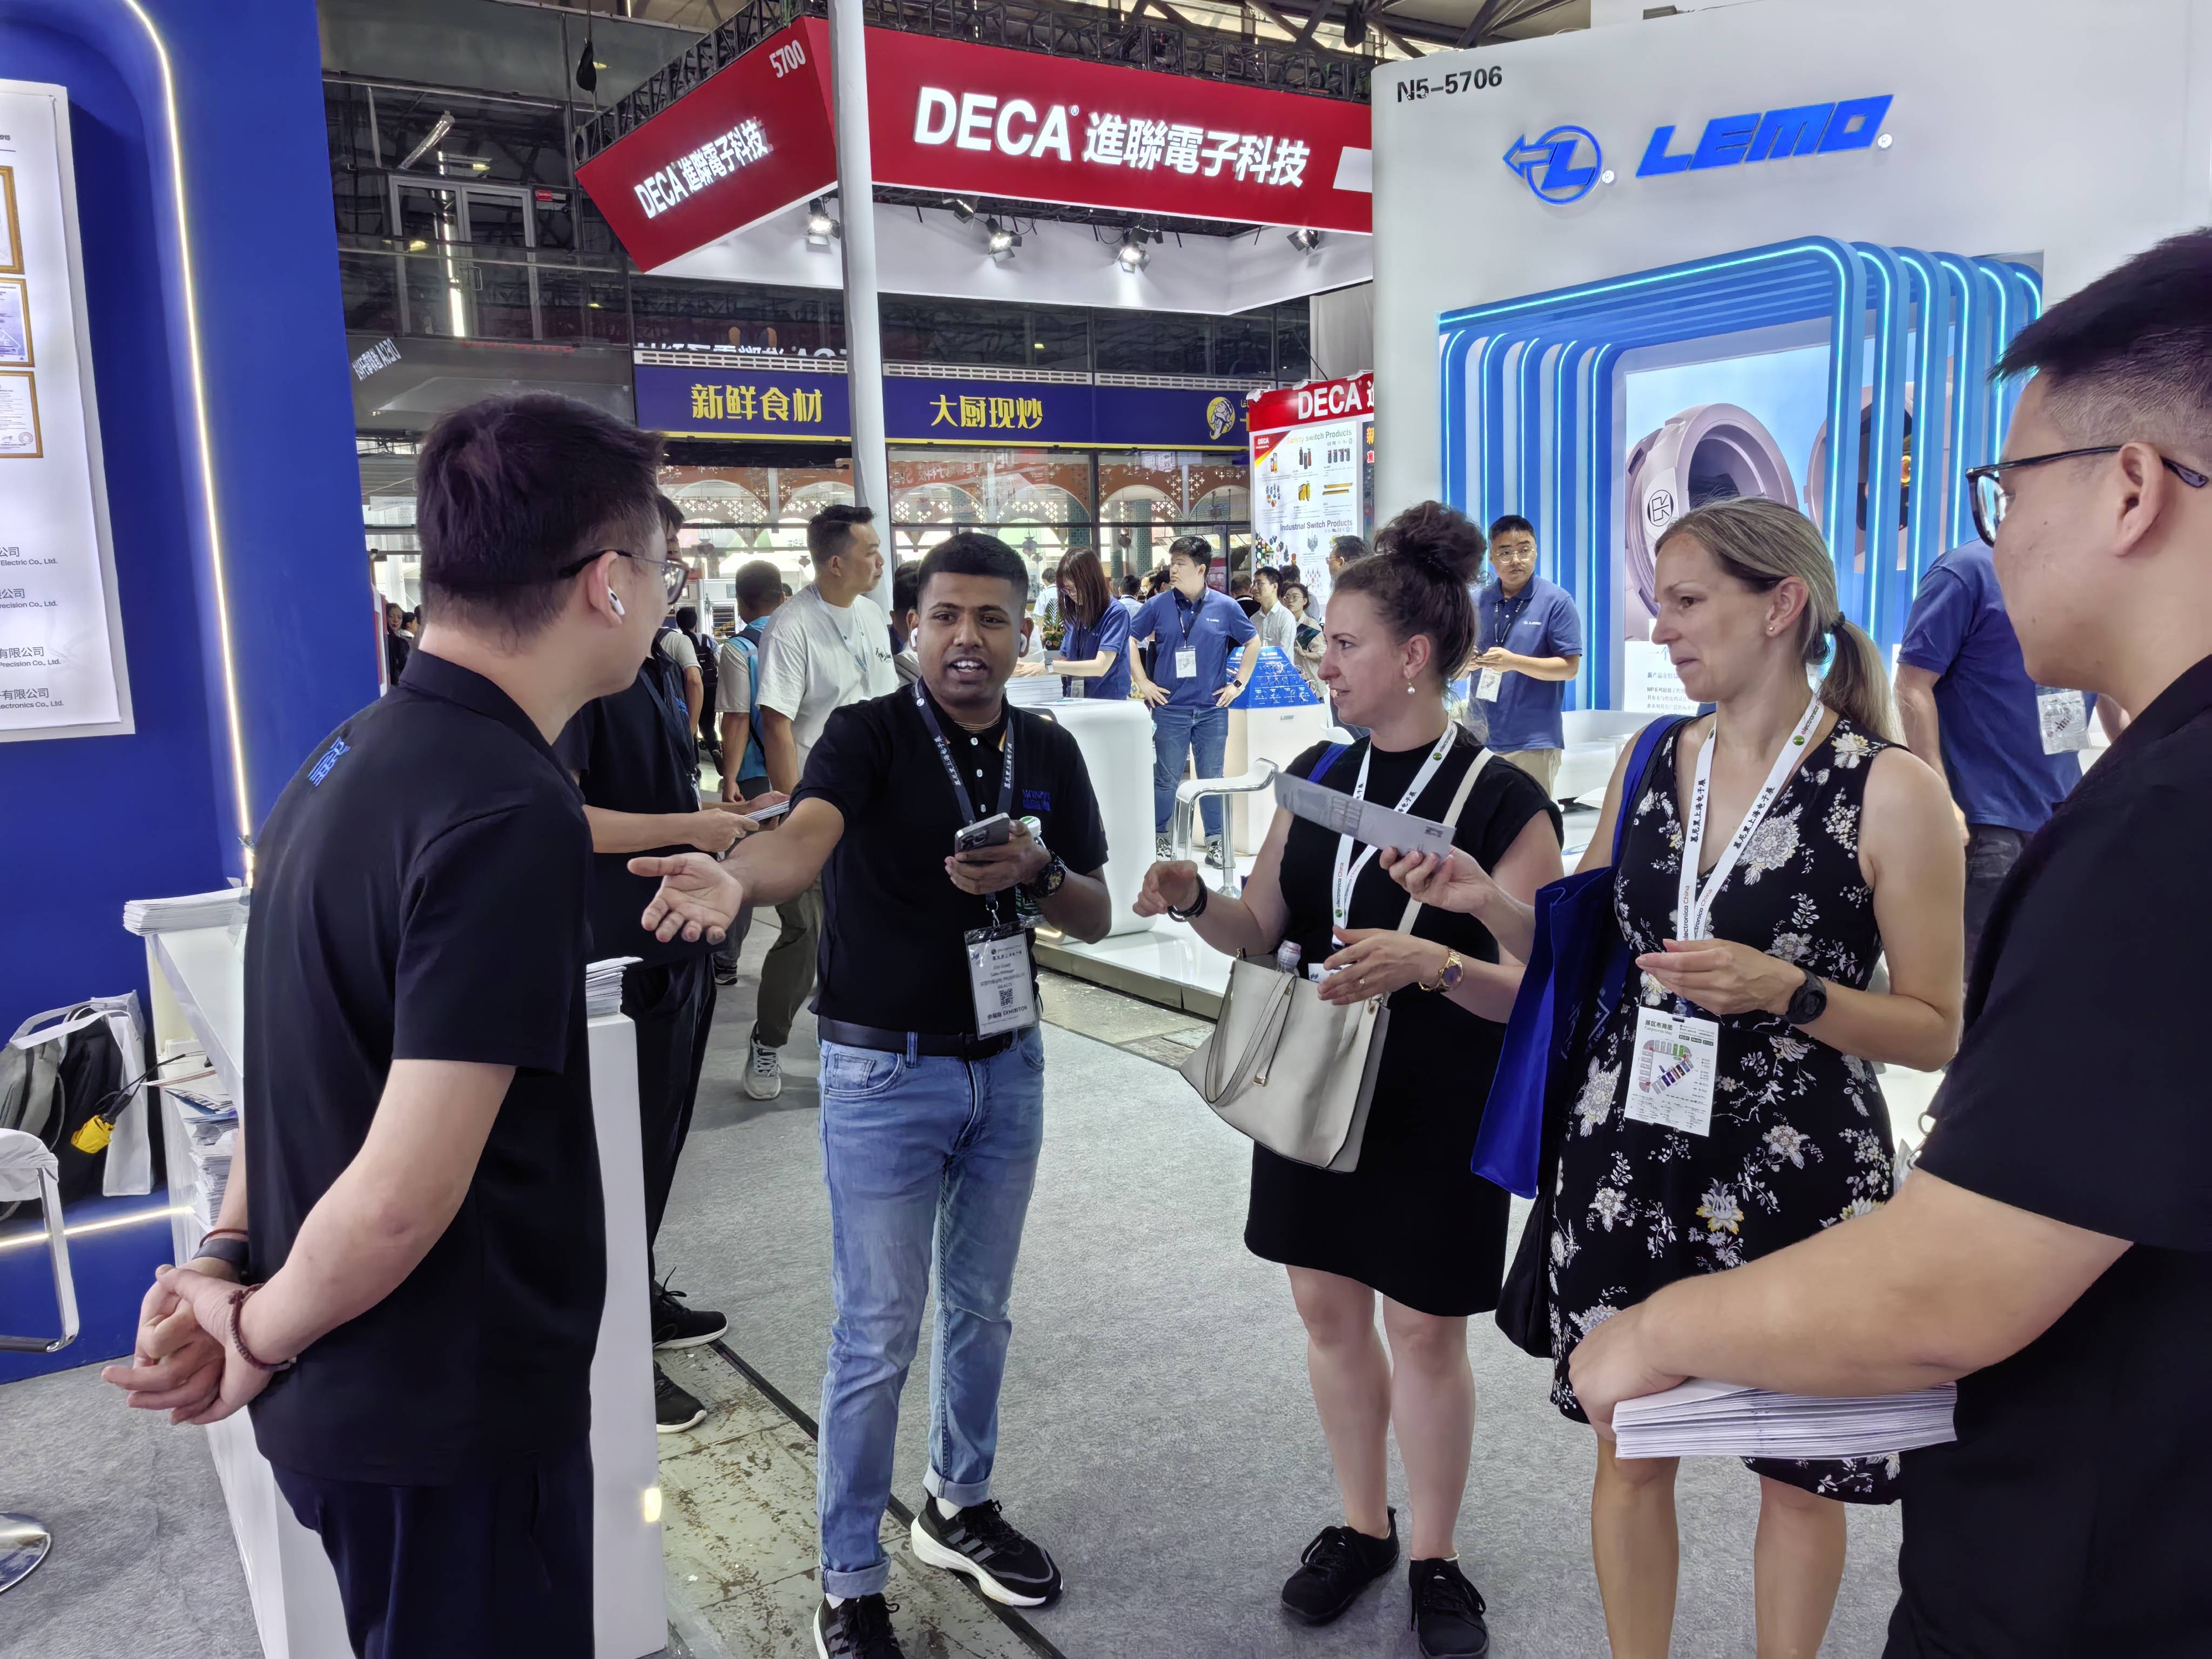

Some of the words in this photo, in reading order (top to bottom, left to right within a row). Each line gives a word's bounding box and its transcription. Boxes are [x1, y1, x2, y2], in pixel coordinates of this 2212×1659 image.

[769, 40, 805, 78] 5700
[1397, 65, 1502, 102] N5-5706
[914, 87, 1073, 161] DECA
[1083, 113, 1310, 187] 進聯電子科技
[1636, 94, 1894, 178] LEMO
[634, 166, 689, 219] DECA
[691, 384, 822, 422] 新鲜食材
[930, 395, 1043, 429] 大厨现炒
[1298, 382, 1362, 420] DECA
[1326, 429, 1352, 439] Products
[1280, 521, 1305, 531] Industrial
[1307, 521, 1325, 529] Switch
[1327, 519, 1352, 528] Products
[0, 589, 25, 599] 公司
[0, 646, 44, 659] 有限公司
[0, 688, 49, 700] 有限公司
[1690, 778, 1706, 842] 慕尼黑上海电子展
[1733, 787, 1775, 849] 慕尼黑上海电子展
[1701, 889, 1712, 906] China
